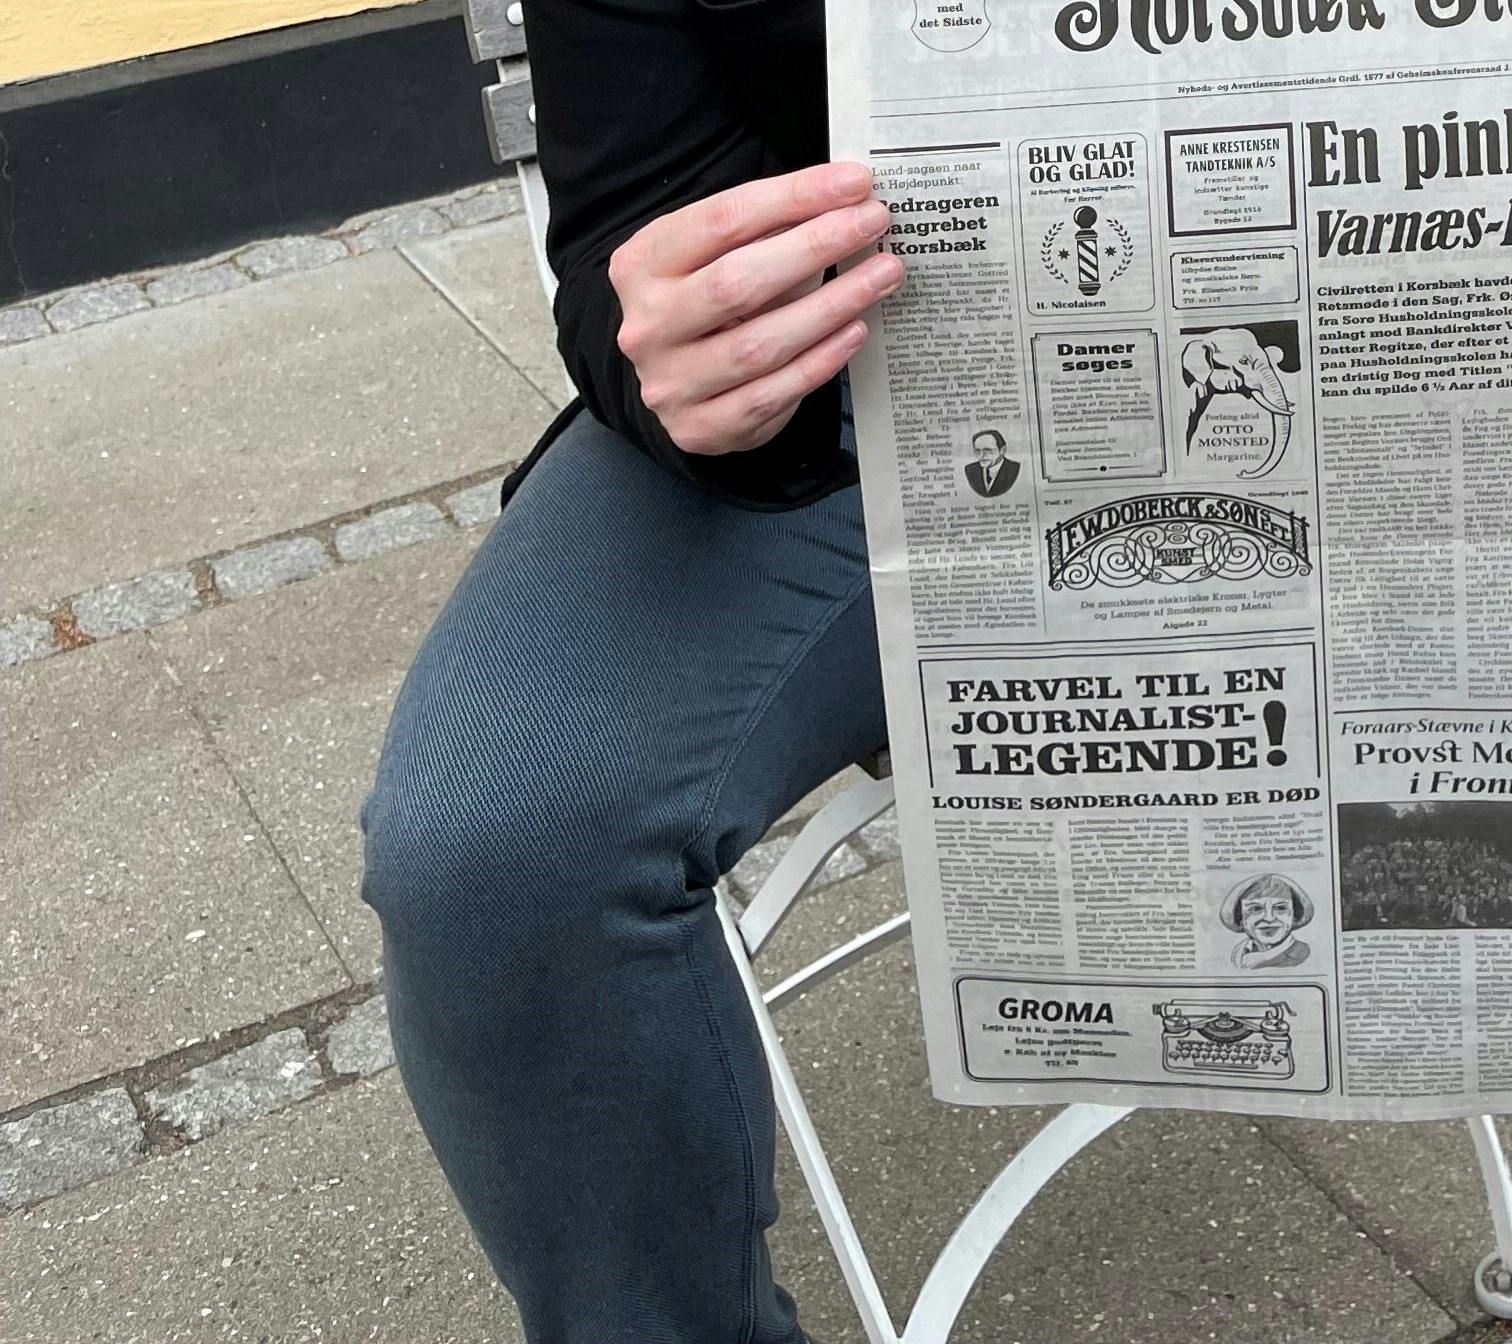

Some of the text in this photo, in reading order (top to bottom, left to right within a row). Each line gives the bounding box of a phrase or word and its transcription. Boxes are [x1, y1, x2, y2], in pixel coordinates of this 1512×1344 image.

[937, 3, 963, 12] med
[920, 17, 982, 28] det Sidste
[1029, 141, 1136, 164] BLIV GLAT
[1180, 138, 1279, 156] ANNE KRESTENSEN
[1306, 121, 1381, 187] En
[954, 163, 980, 172] naar
[1030, 160, 1134, 183] OG GLAD!
[1186, 156, 1275, 173] TANDTEKNIK A/S
[873, 176, 960, 190] et Højdepunkt
[890, 237, 987, 256] Korsbæk
[1317, 285, 1394, 296] Civilretten
[1398, 282, 1403, 292] i
[1406, 279, 1470, 291] Korsbæk
[1052, 300, 1106, 308] Nicolaisen
[1318, 299, 1389, 311] Retsmøde
[1393, 298, 1398, 307] i
[1402, 297, 1428, 306] den
[1432, 296, 1462, 306] Sag,
[1467, 293, 1495, 303] Frk.
[1318, 317, 1338, 326] fra
[1342, 316, 1374, 324] Sorø
[1319, 330, 1366, 341] anlagt
[1370, 328, 1402, 338] mod
[1406, 323, 1502, 336] Bankdirektør
[1058, 344, 1135, 356] Damer
[1319, 346, 1366, 354] Datter
[1369, 342, 1426, 353] Regitze,
[1431, 340, 1454, 349] der
[1458, 338, 1492, 347] efter
[1495, 336, 1509, 345] et
[1062, 360, 1133, 372] søges
[1320, 362, 1346, 371] paa
[1350, 351, 1496, 370] Husholdningsskolen
[1342, 371, 1389, 382] dristig
[1393, 371, 1420, 380] Bog
[1425, 368, 1456, 378] med
[1460, 366, 1502, 376] Titlen
[1321, 389, 1348, 397] kan
[1352, 387, 1370, 395] du
[1375, 384, 1417, 396] spilde
[1421, 383, 1429, 392] 6
[1449, 382, 1474, 390] Aar
[1478, 380, 1492, 389] af
[1240, 412, 1259, 420] altid
[1212, 425, 1253, 434] OTTO
[1198, 437, 1269, 447] MØNSTED
[947, 667, 1286, 704] FARVEL TIL EN
[951, 703, 1256, 735] JOURNALIST-
[1341, 718, 1484, 735] Foraars-Stævne
[1489, 720, 1495, 733] i
[1355, 740, 1462, 765] Provst
[1410, 772, 1420, 794] i
[932, 788, 1320, 810] LOUISE SØNDERGAARD ER DØD
[999, 998, 1113, 1024] GROMA
